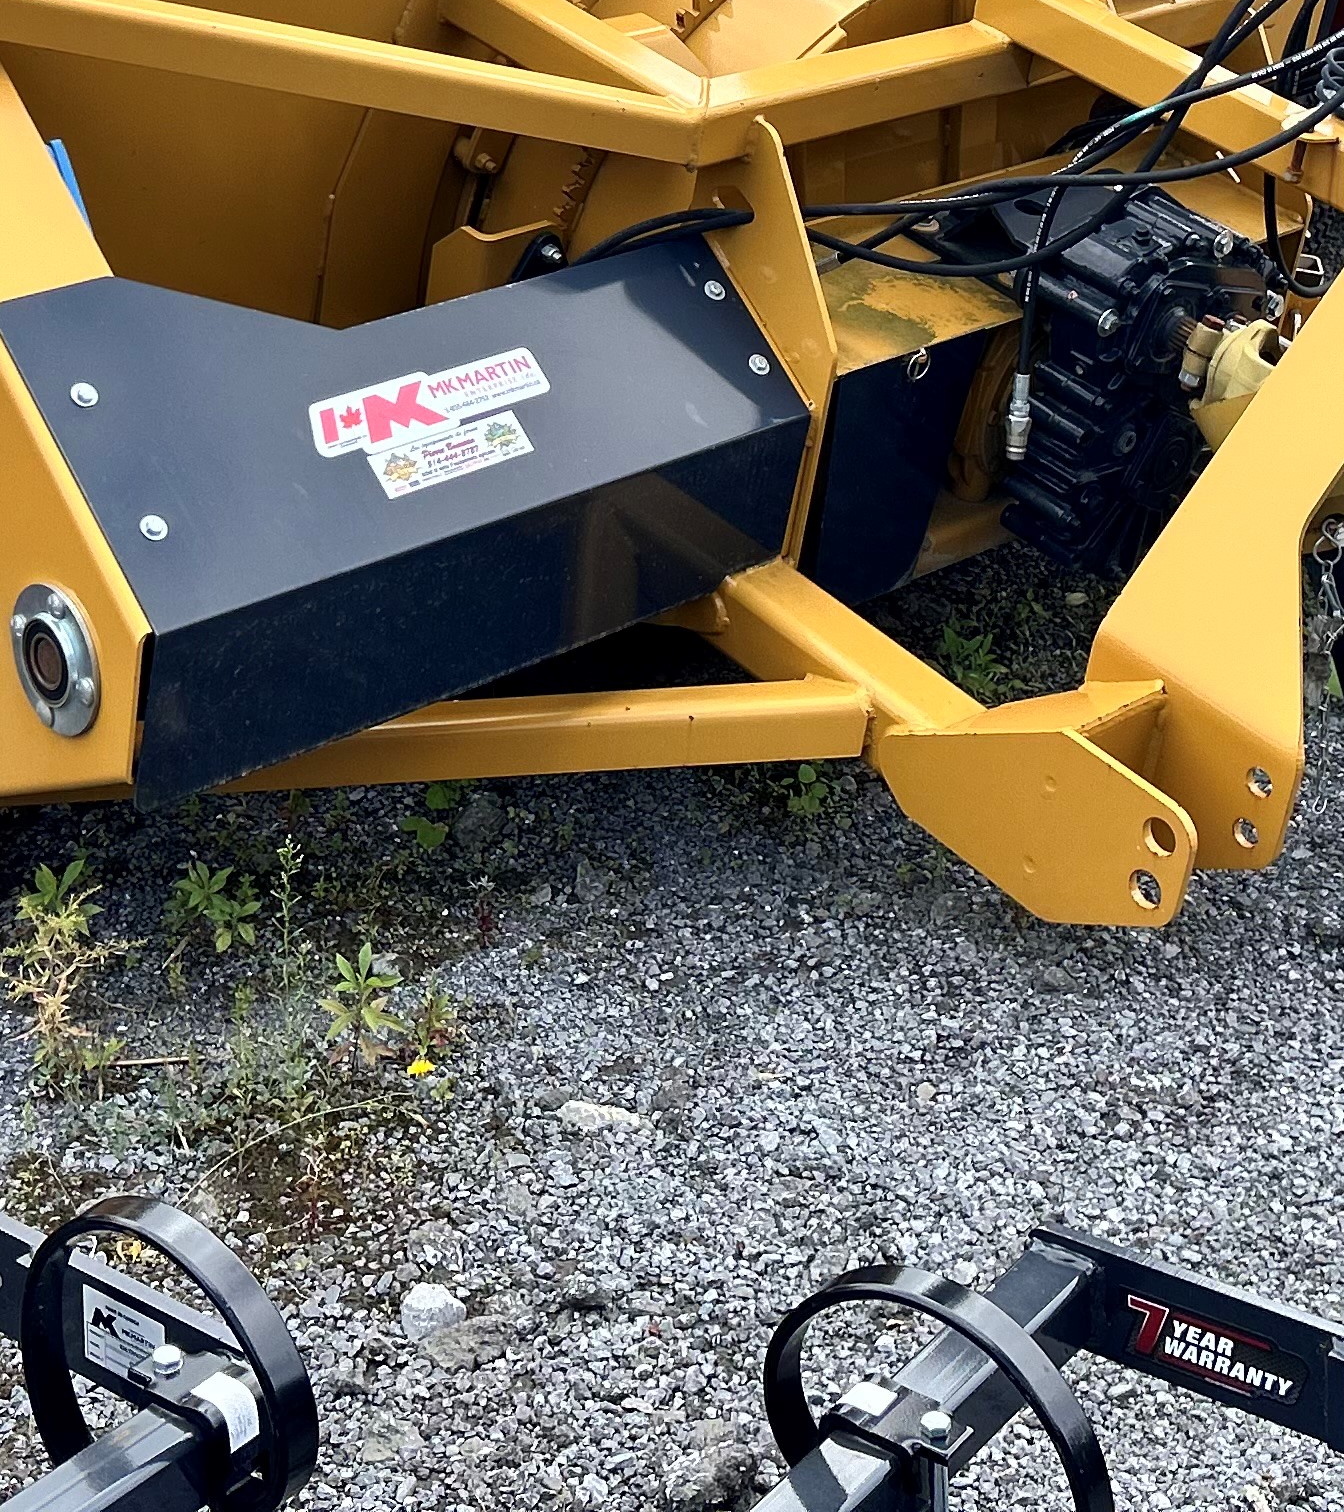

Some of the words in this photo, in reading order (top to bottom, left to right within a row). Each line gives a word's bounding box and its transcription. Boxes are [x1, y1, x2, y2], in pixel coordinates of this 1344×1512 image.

[1127, 1294, 1170, 1356] 7
[1172, 1319, 1235, 1358] YEAR
[1164, 1336, 1294, 1397] WARRANTY
